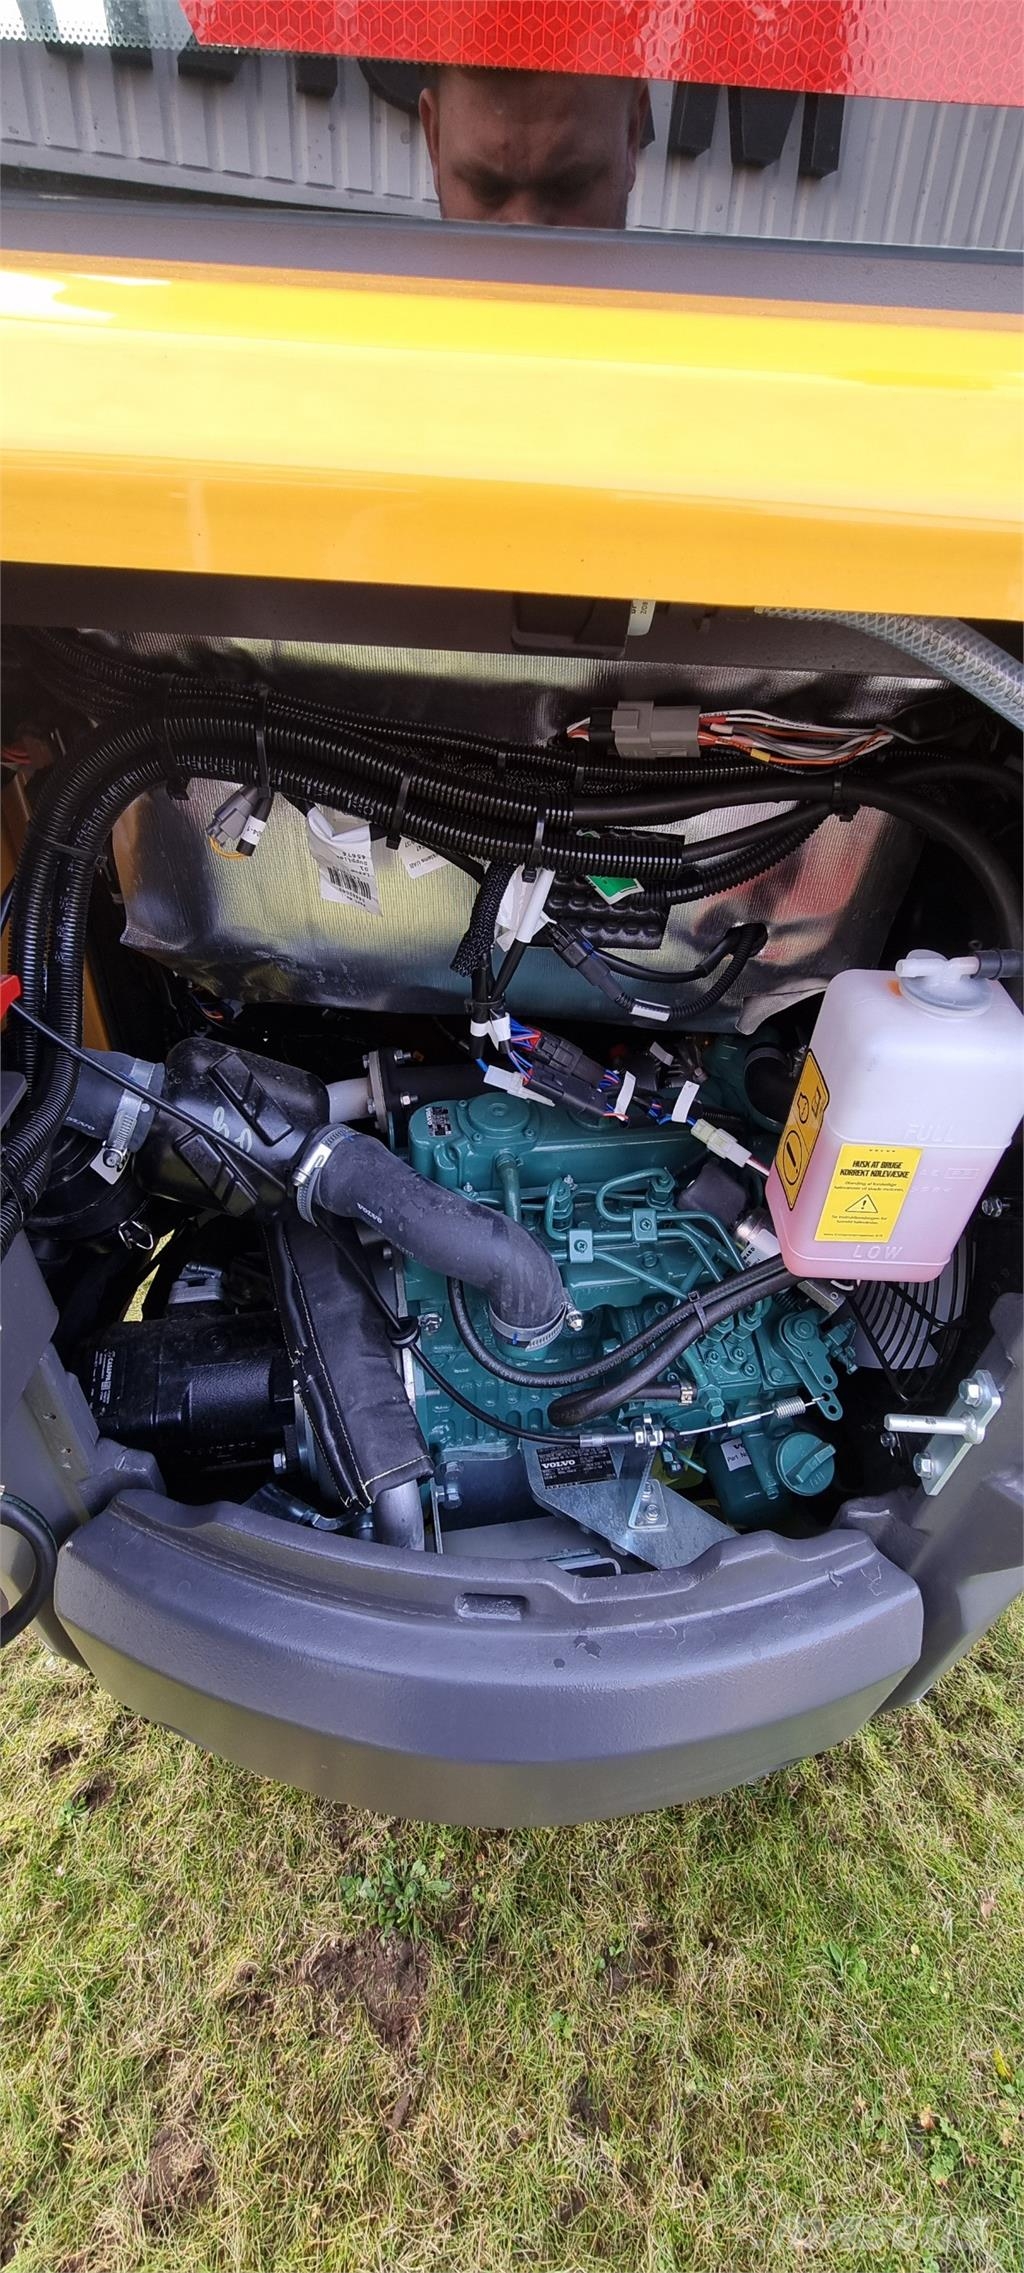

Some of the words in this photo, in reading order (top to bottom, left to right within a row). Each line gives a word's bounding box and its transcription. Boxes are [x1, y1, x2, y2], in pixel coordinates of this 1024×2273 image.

[904, 1122, 953, 1143] FULL
[852, 1160, 870, 1169] HUSK
[871, 1160, 880, 1169] AT
[880, 1161, 903, 1169] BRUGE
[840, 1168, 869, 1177] KORREKT
[356, 1202, 383, 1224] VOLVO
[853, 1244, 903, 1260] LOW
[541, 1459, 576, 1469] VOLVO
